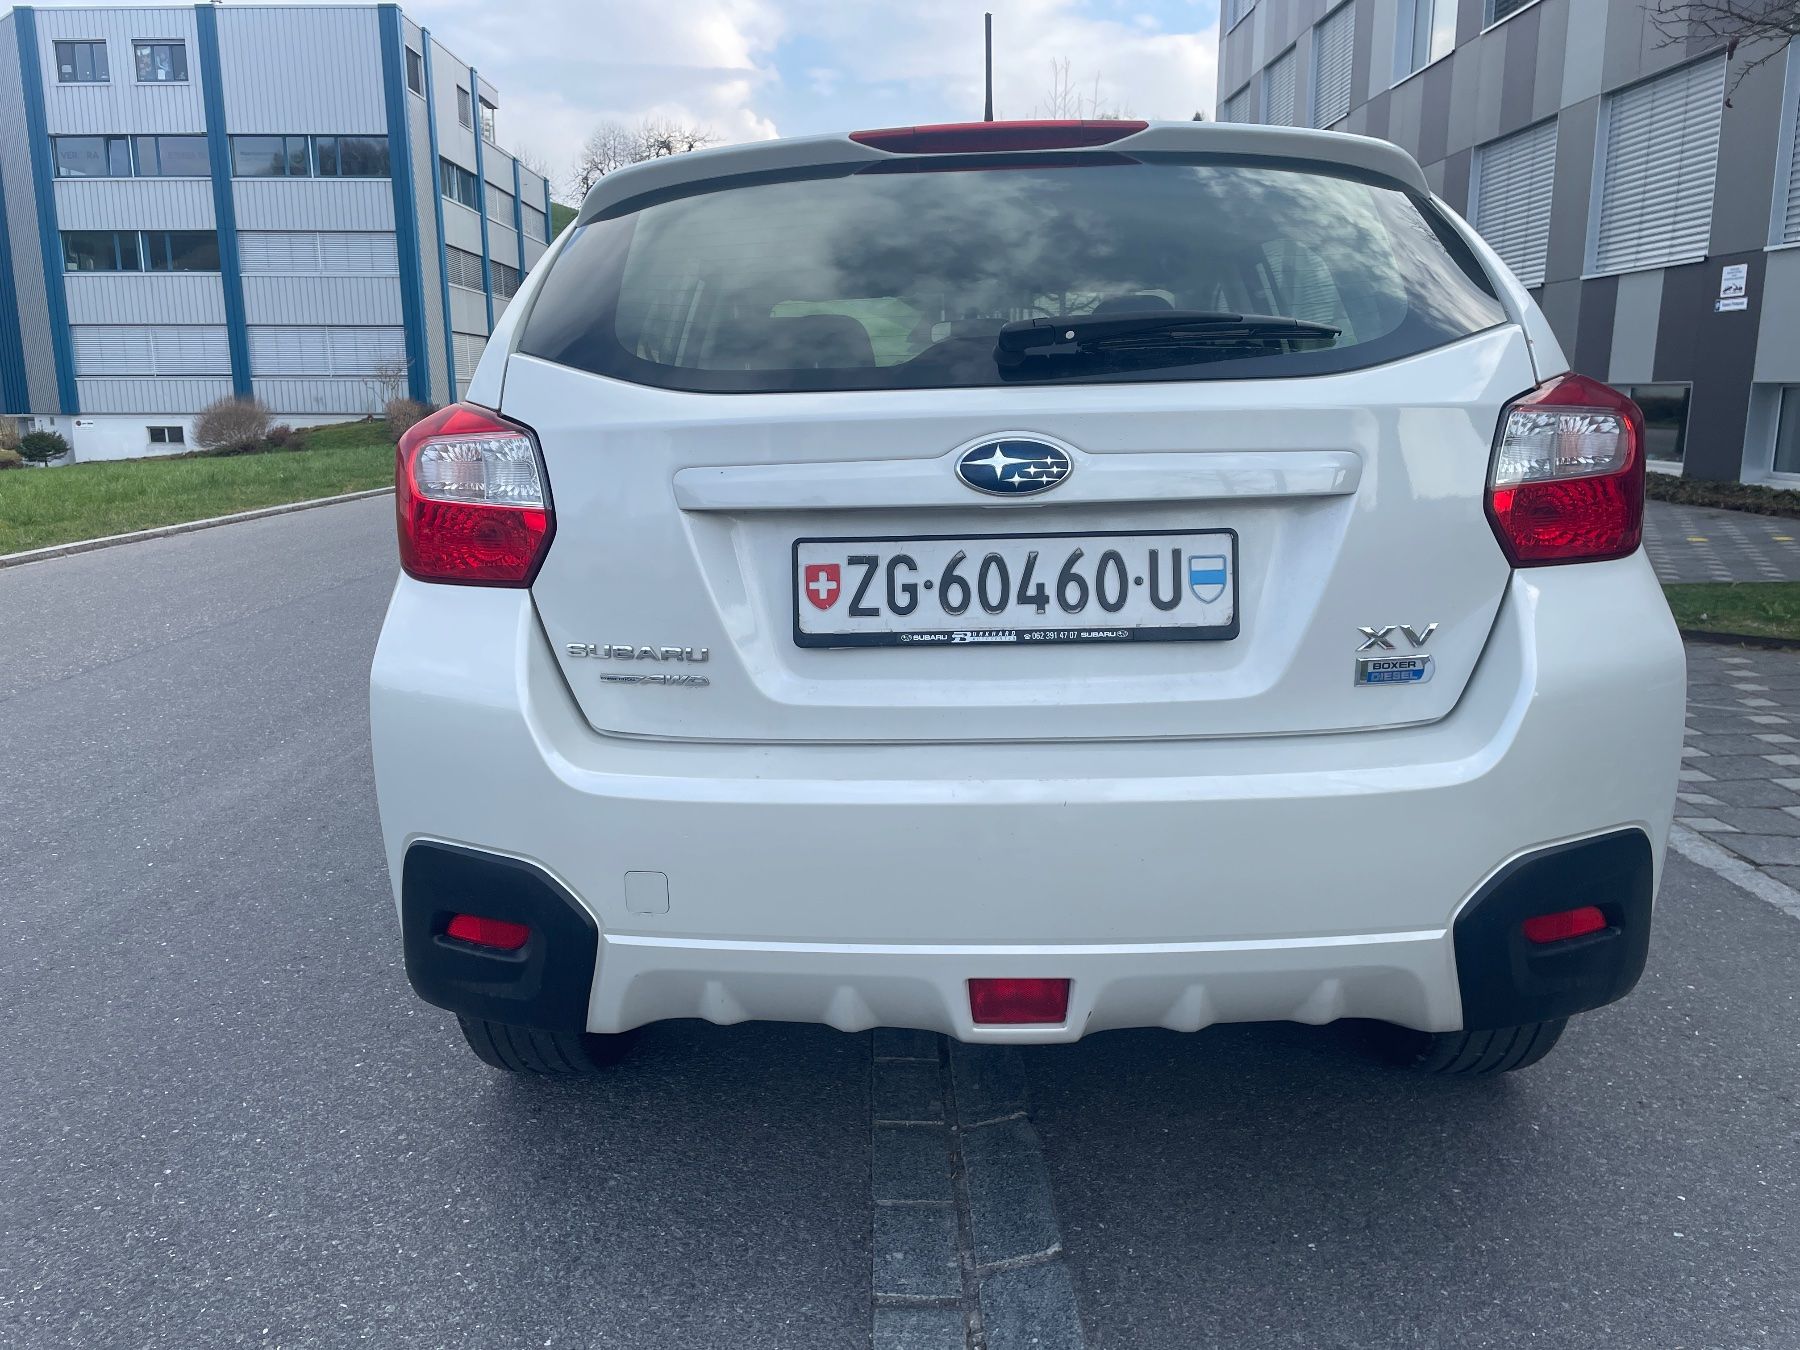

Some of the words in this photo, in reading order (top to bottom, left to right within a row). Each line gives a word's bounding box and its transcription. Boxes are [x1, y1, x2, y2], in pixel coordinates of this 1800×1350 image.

[1032, 631, 1044, 640] 062
[1046, 631, 1058, 639] 391
[1060, 631, 1068, 639] 47
[1070, 631, 1078, 639] 07
[1356, 622, 1439, 651] XV
[566, 643, 710, 663] SUBARU
[1372, 661, 1417, 670] BOXER
[1370, 671, 1418, 681] DIESEL
